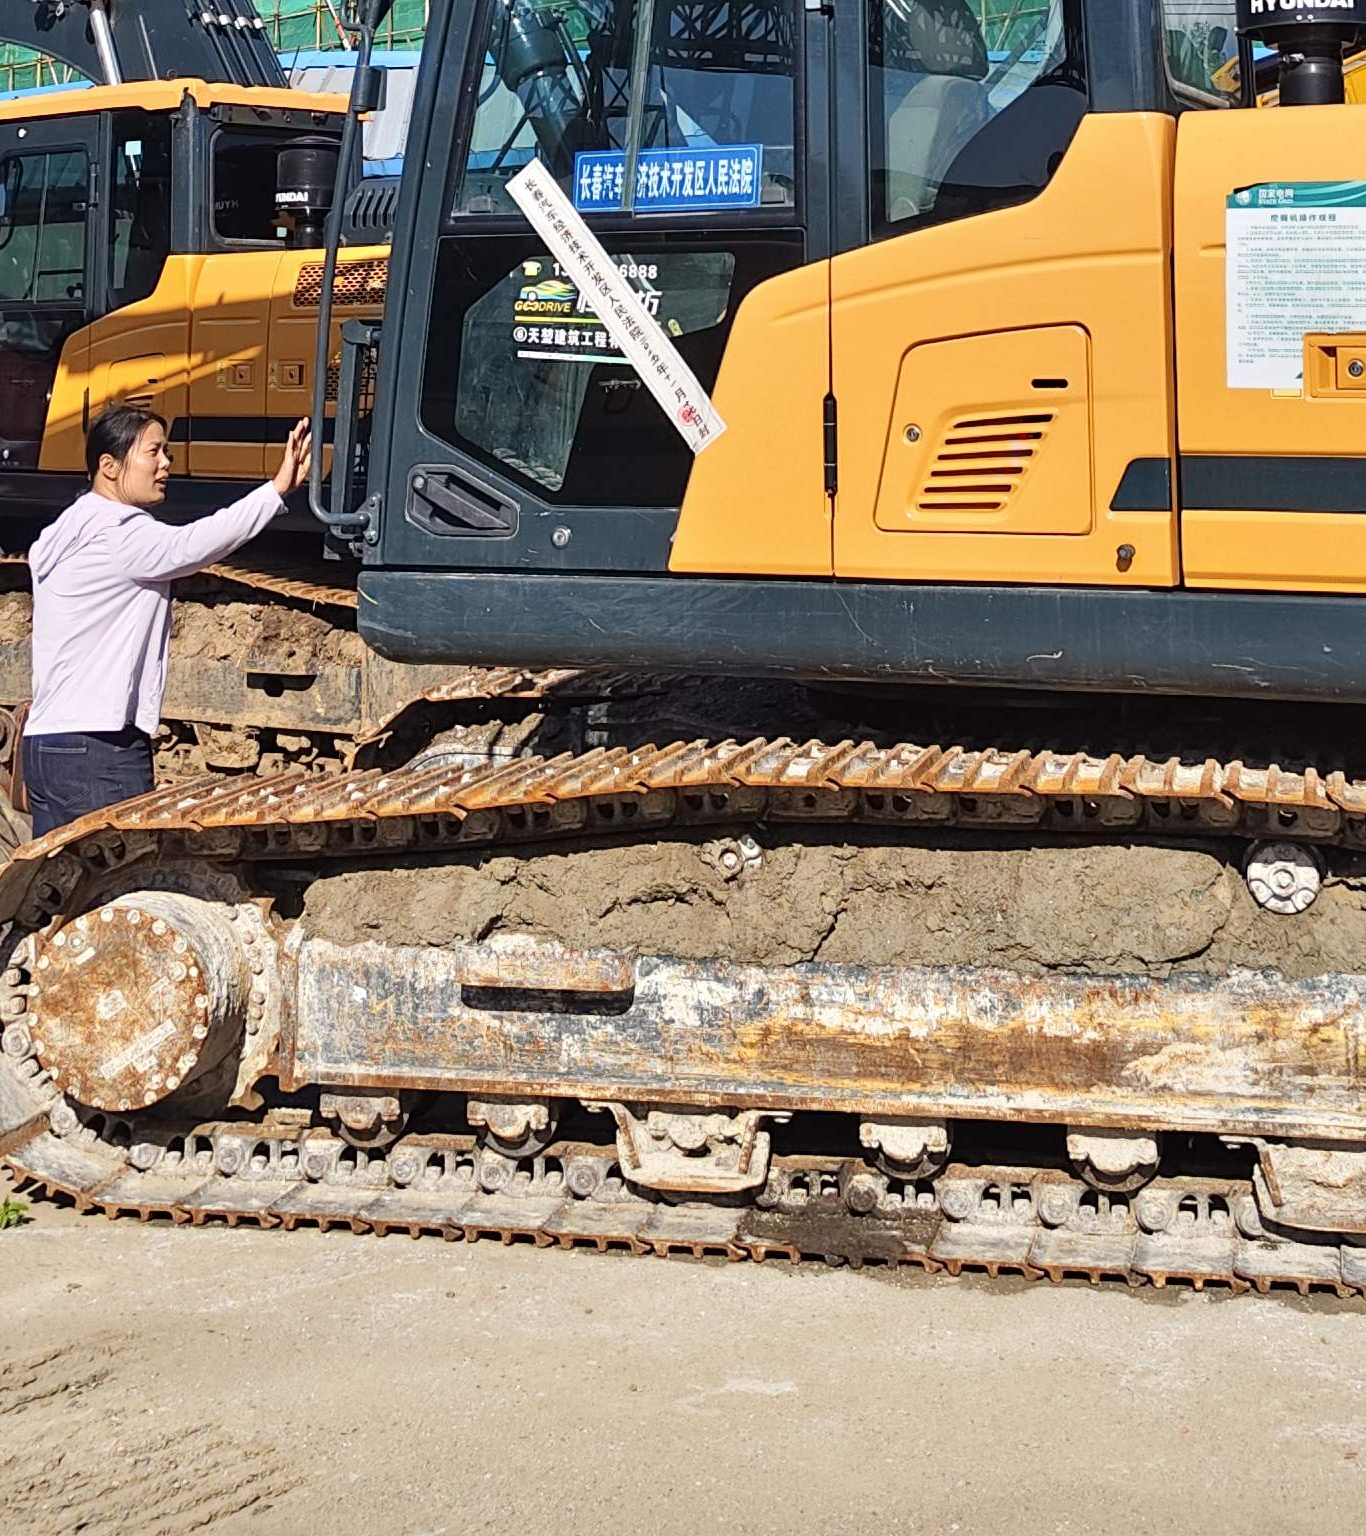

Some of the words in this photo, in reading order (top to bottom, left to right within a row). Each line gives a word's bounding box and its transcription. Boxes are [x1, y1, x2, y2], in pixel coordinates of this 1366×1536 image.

[580, 157, 753, 201] 长春汽车济技术开发区人民法院
